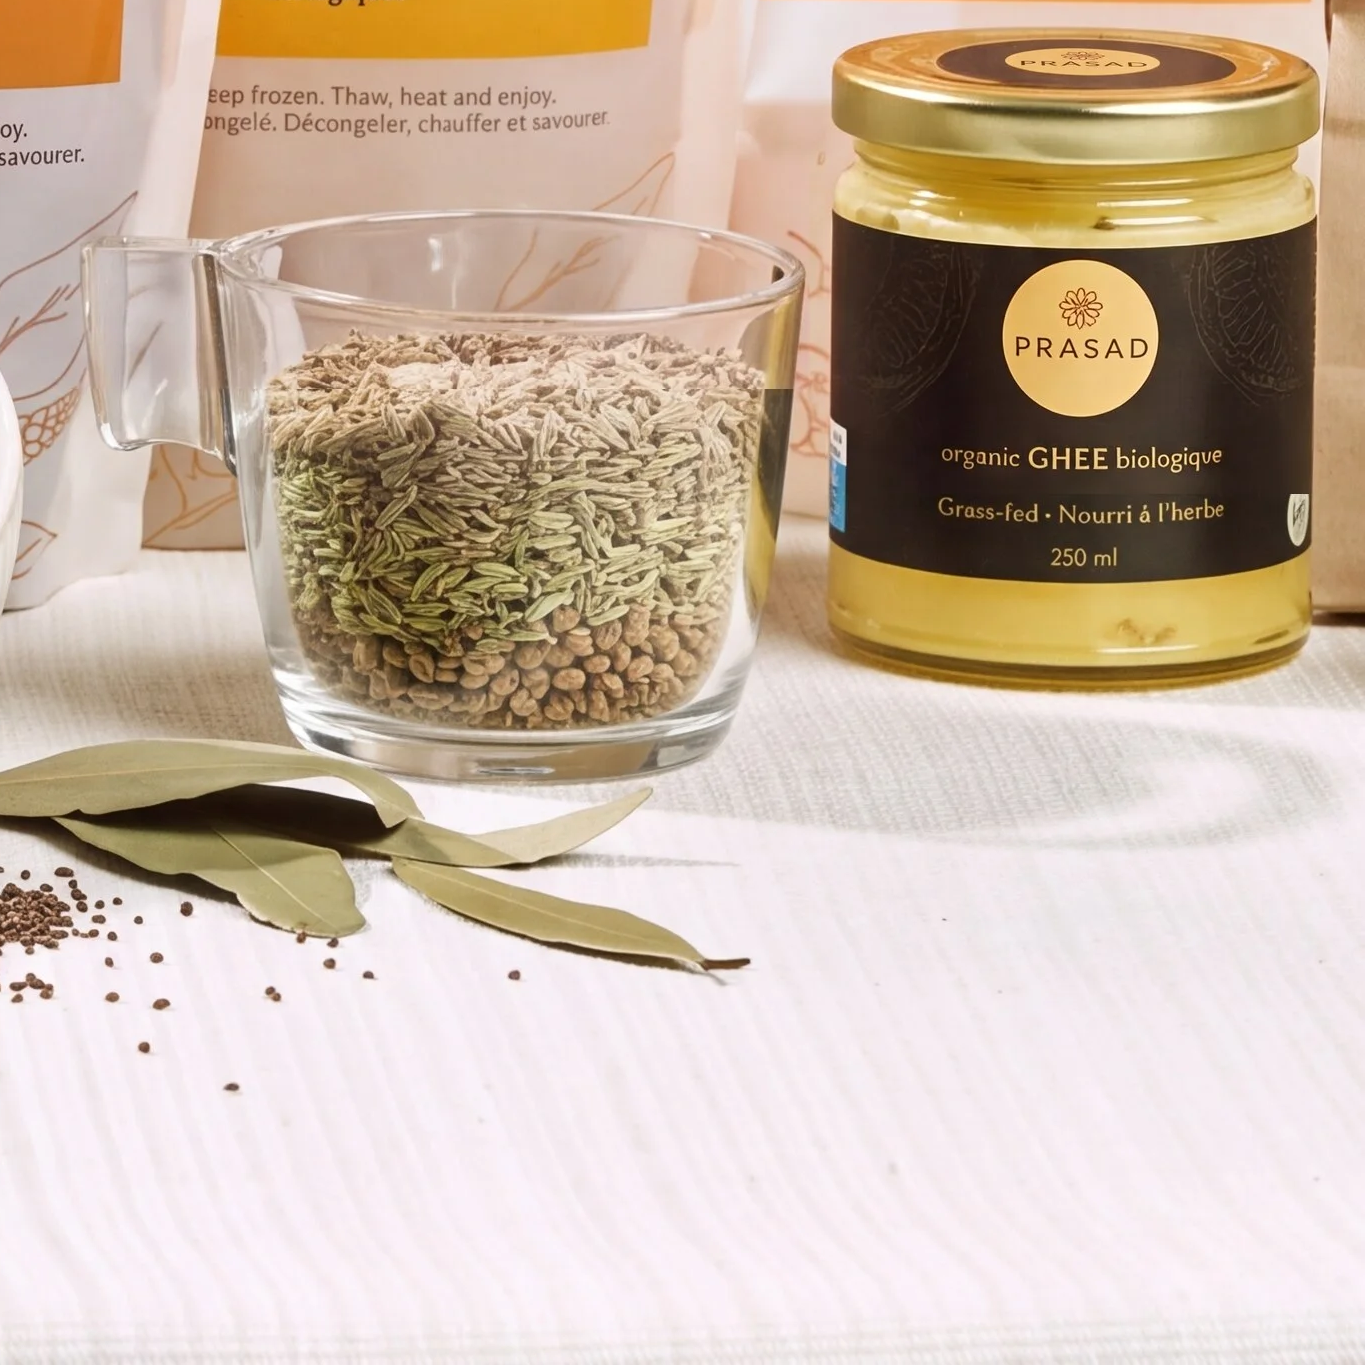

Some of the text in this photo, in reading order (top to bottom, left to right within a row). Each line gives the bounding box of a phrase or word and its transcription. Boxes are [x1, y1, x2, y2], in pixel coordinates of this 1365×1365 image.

[1019, 59, 1148, 70] PRASAD
[1015, 336, 1149, 359] PRASAD
[941, 446, 1222, 474] organic GHEE biologique
[938, 496, 1039, 523] Grass-fed
[1059, 504, 1132, 524] Nourri
[1050, 546, 1117, 567] 250 ml
